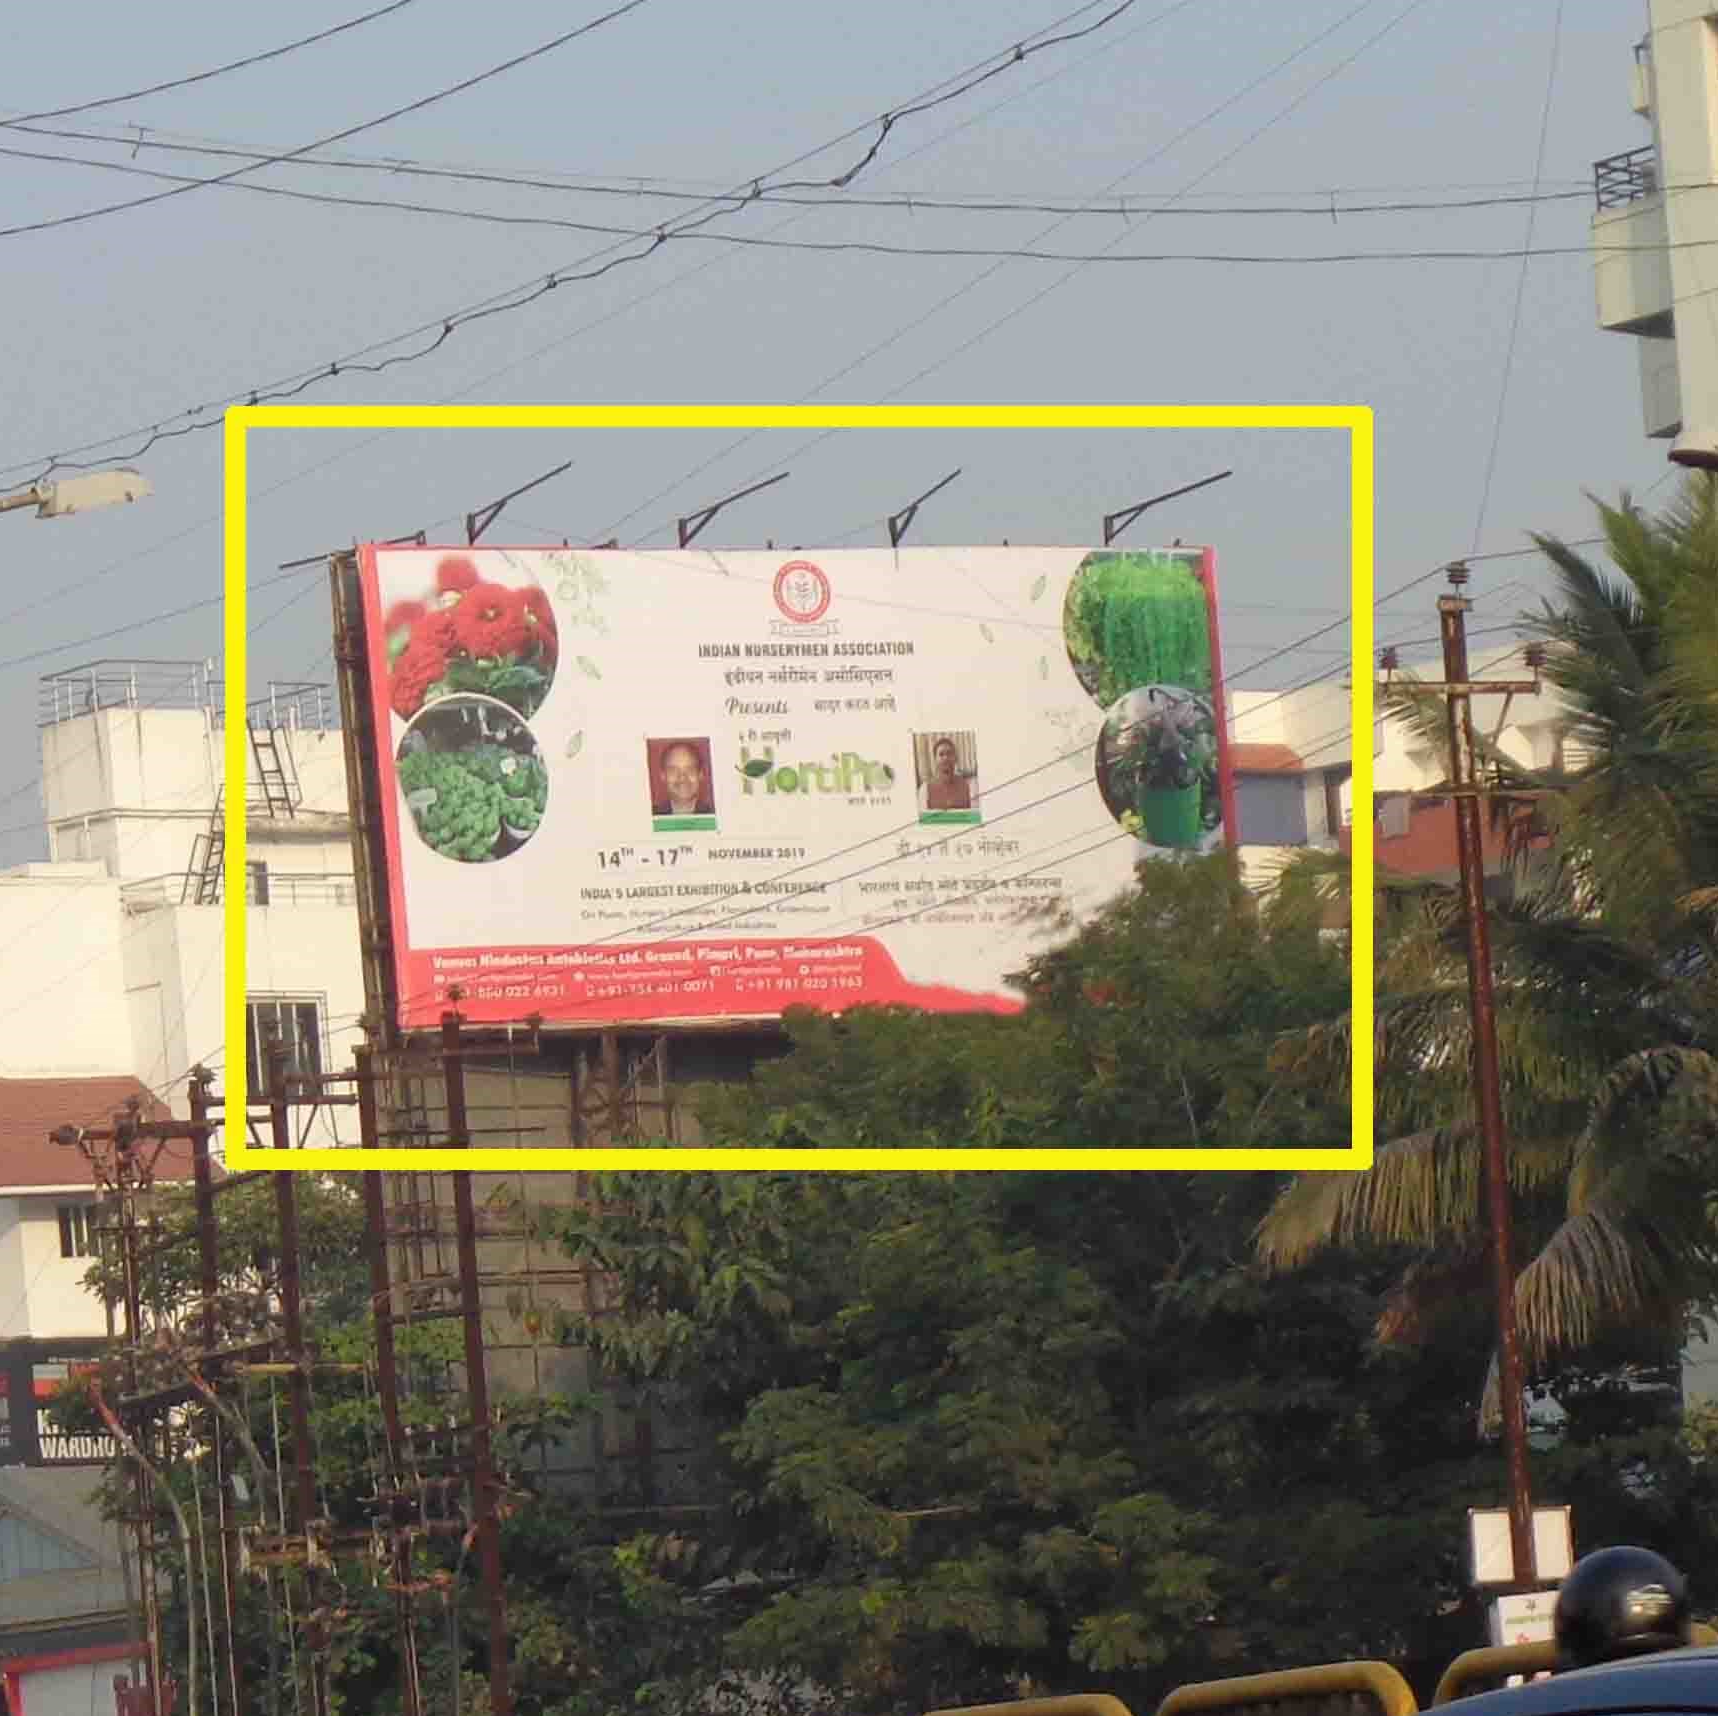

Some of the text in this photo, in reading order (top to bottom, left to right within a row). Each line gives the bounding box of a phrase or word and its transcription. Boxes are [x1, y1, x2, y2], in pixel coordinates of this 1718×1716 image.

[698, 641, 915, 658] INDIAN NURSERYMEN ASSOCIATION
[725, 696, 789, 715] Presents
[708, 847, 774, 860] NOVEMBER
[626, 884, 676, 898] LARGEST
[677, 882, 739, 897] EXHIBITION
[754, 881, 828, 895] CONFERENCE
